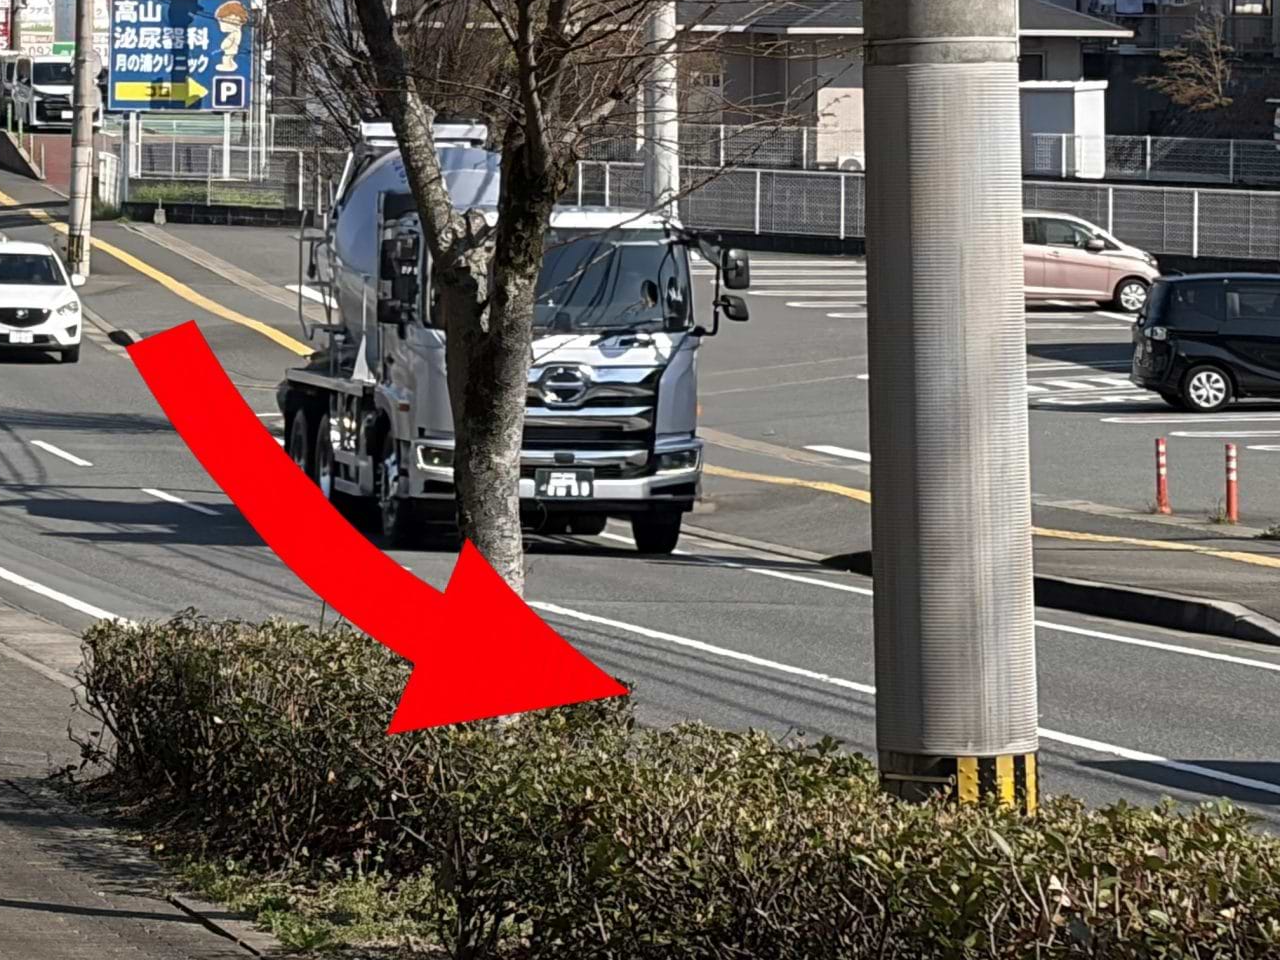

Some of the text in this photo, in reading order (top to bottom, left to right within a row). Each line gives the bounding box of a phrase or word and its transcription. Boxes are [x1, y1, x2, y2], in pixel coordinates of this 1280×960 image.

[114, 0, 163, 23] 高山
[114, 26, 209, 50] 泌尿器科
[115, 53, 209, 73] 月の浦クリニック
[220, 81, 238, 102] P
